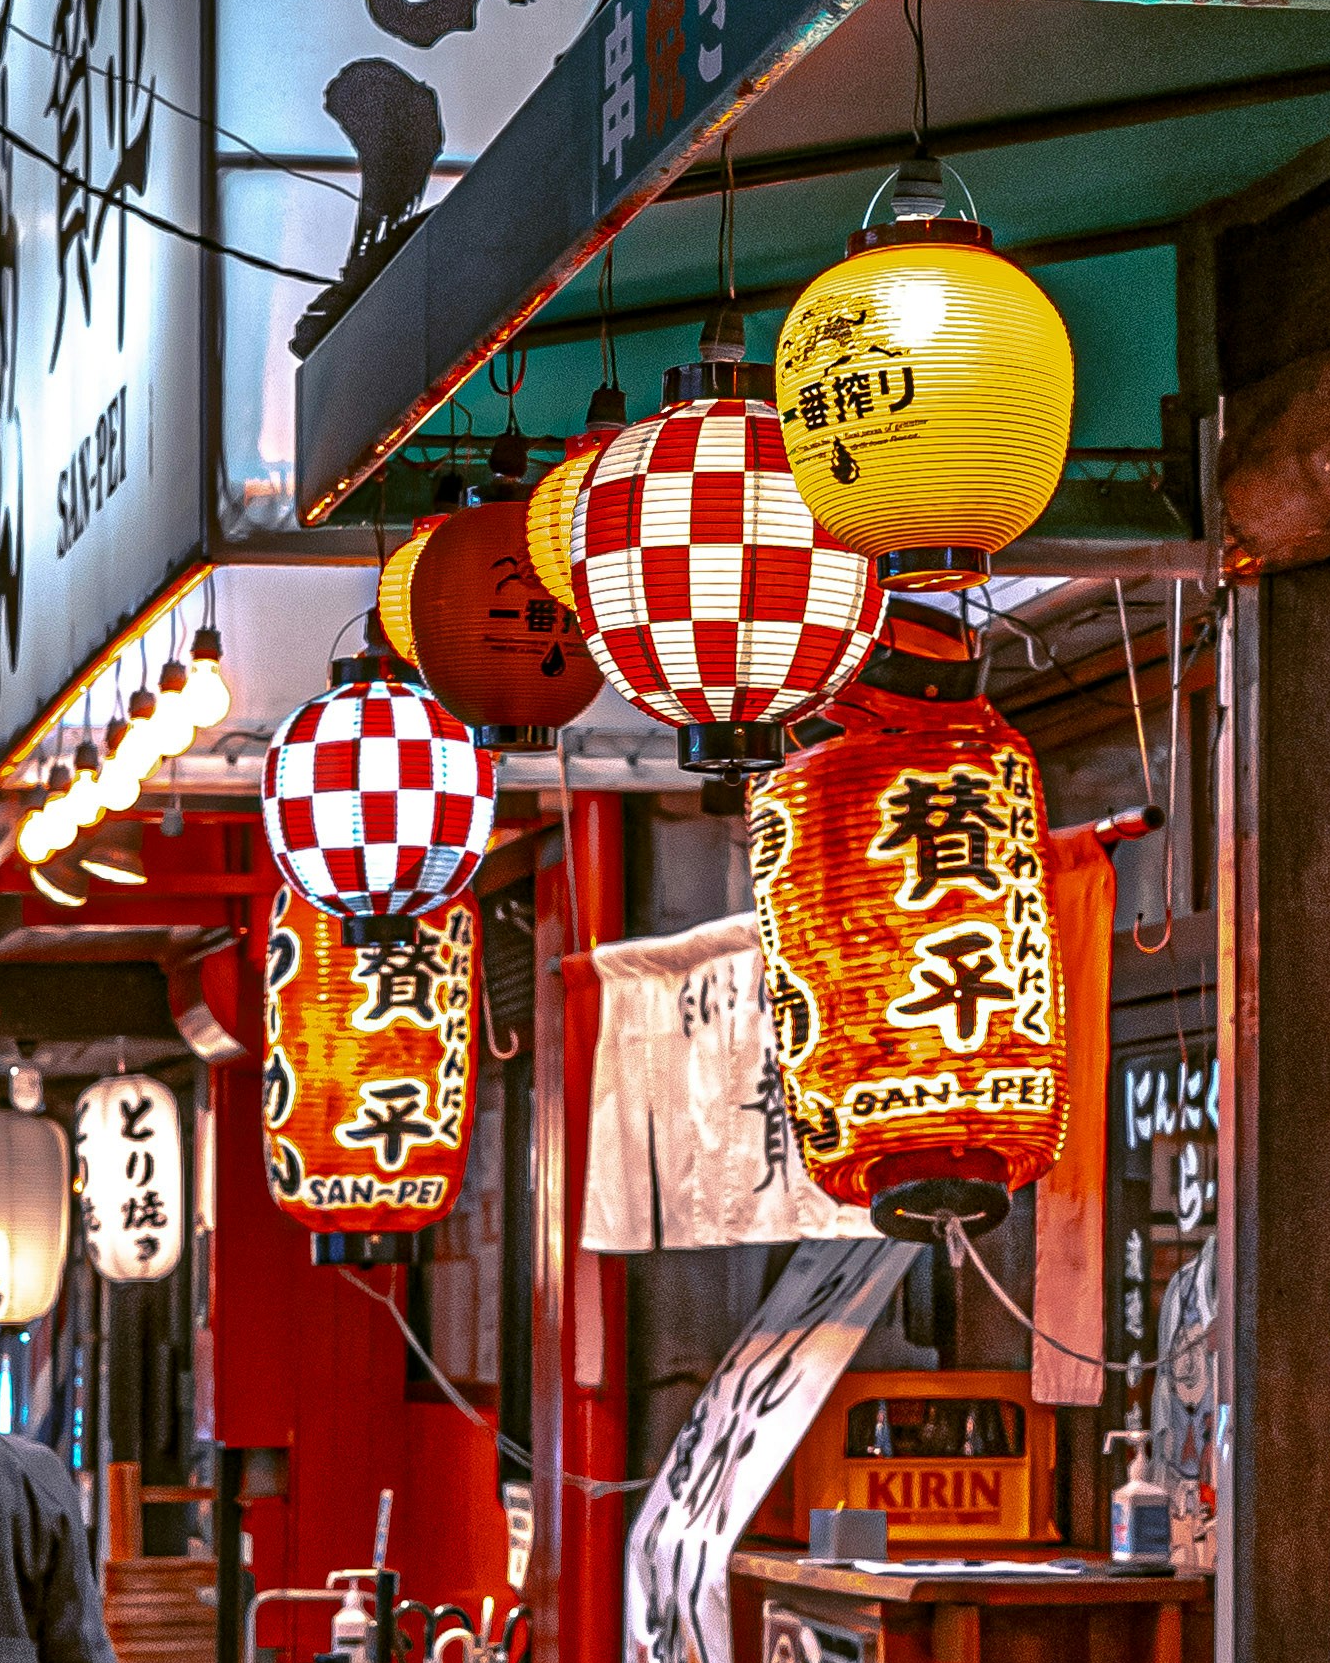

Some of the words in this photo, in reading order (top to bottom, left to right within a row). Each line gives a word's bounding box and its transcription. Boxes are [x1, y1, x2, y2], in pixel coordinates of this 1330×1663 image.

[57, 385, 128, 559] SAN-PEI
[878, 773, 1017, 1040] 賛平
[1001, 752, 1050, 1034] なにわにんにく
[308, 1178, 443, 1206] SAN-PEI
[868, 1468, 1003, 1512] KIRIN
